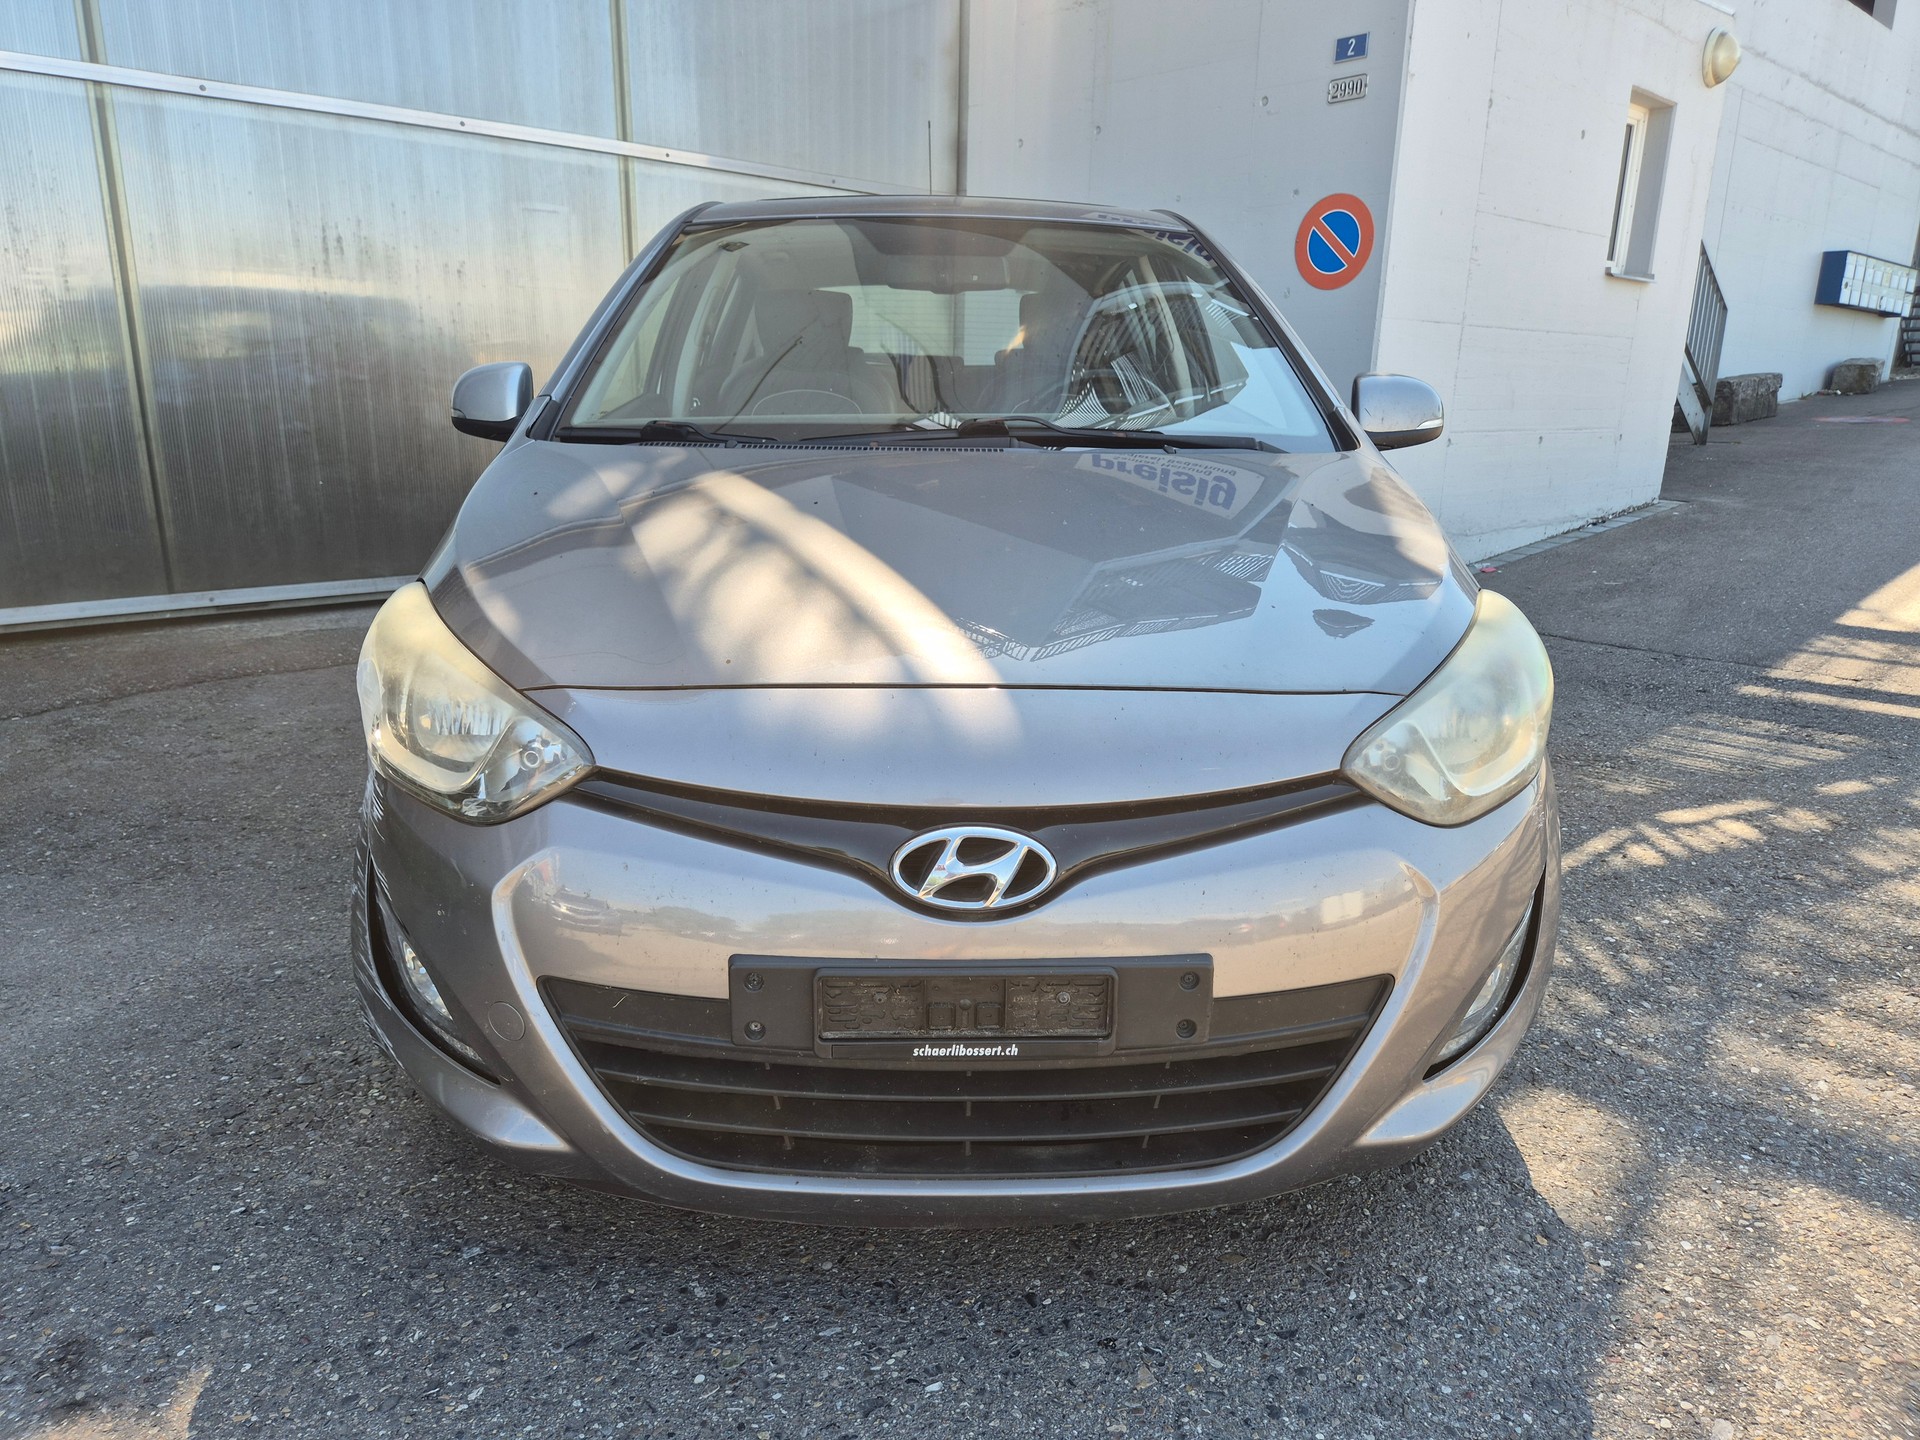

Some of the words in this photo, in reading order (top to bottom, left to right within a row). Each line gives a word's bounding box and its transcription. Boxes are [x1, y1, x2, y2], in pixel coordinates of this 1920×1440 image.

[1347, 38, 1356, 56] 2
[1331, 78, 1363, 99] 2990
[912, 1044, 1018, 1056] schaerlibossert.ch
